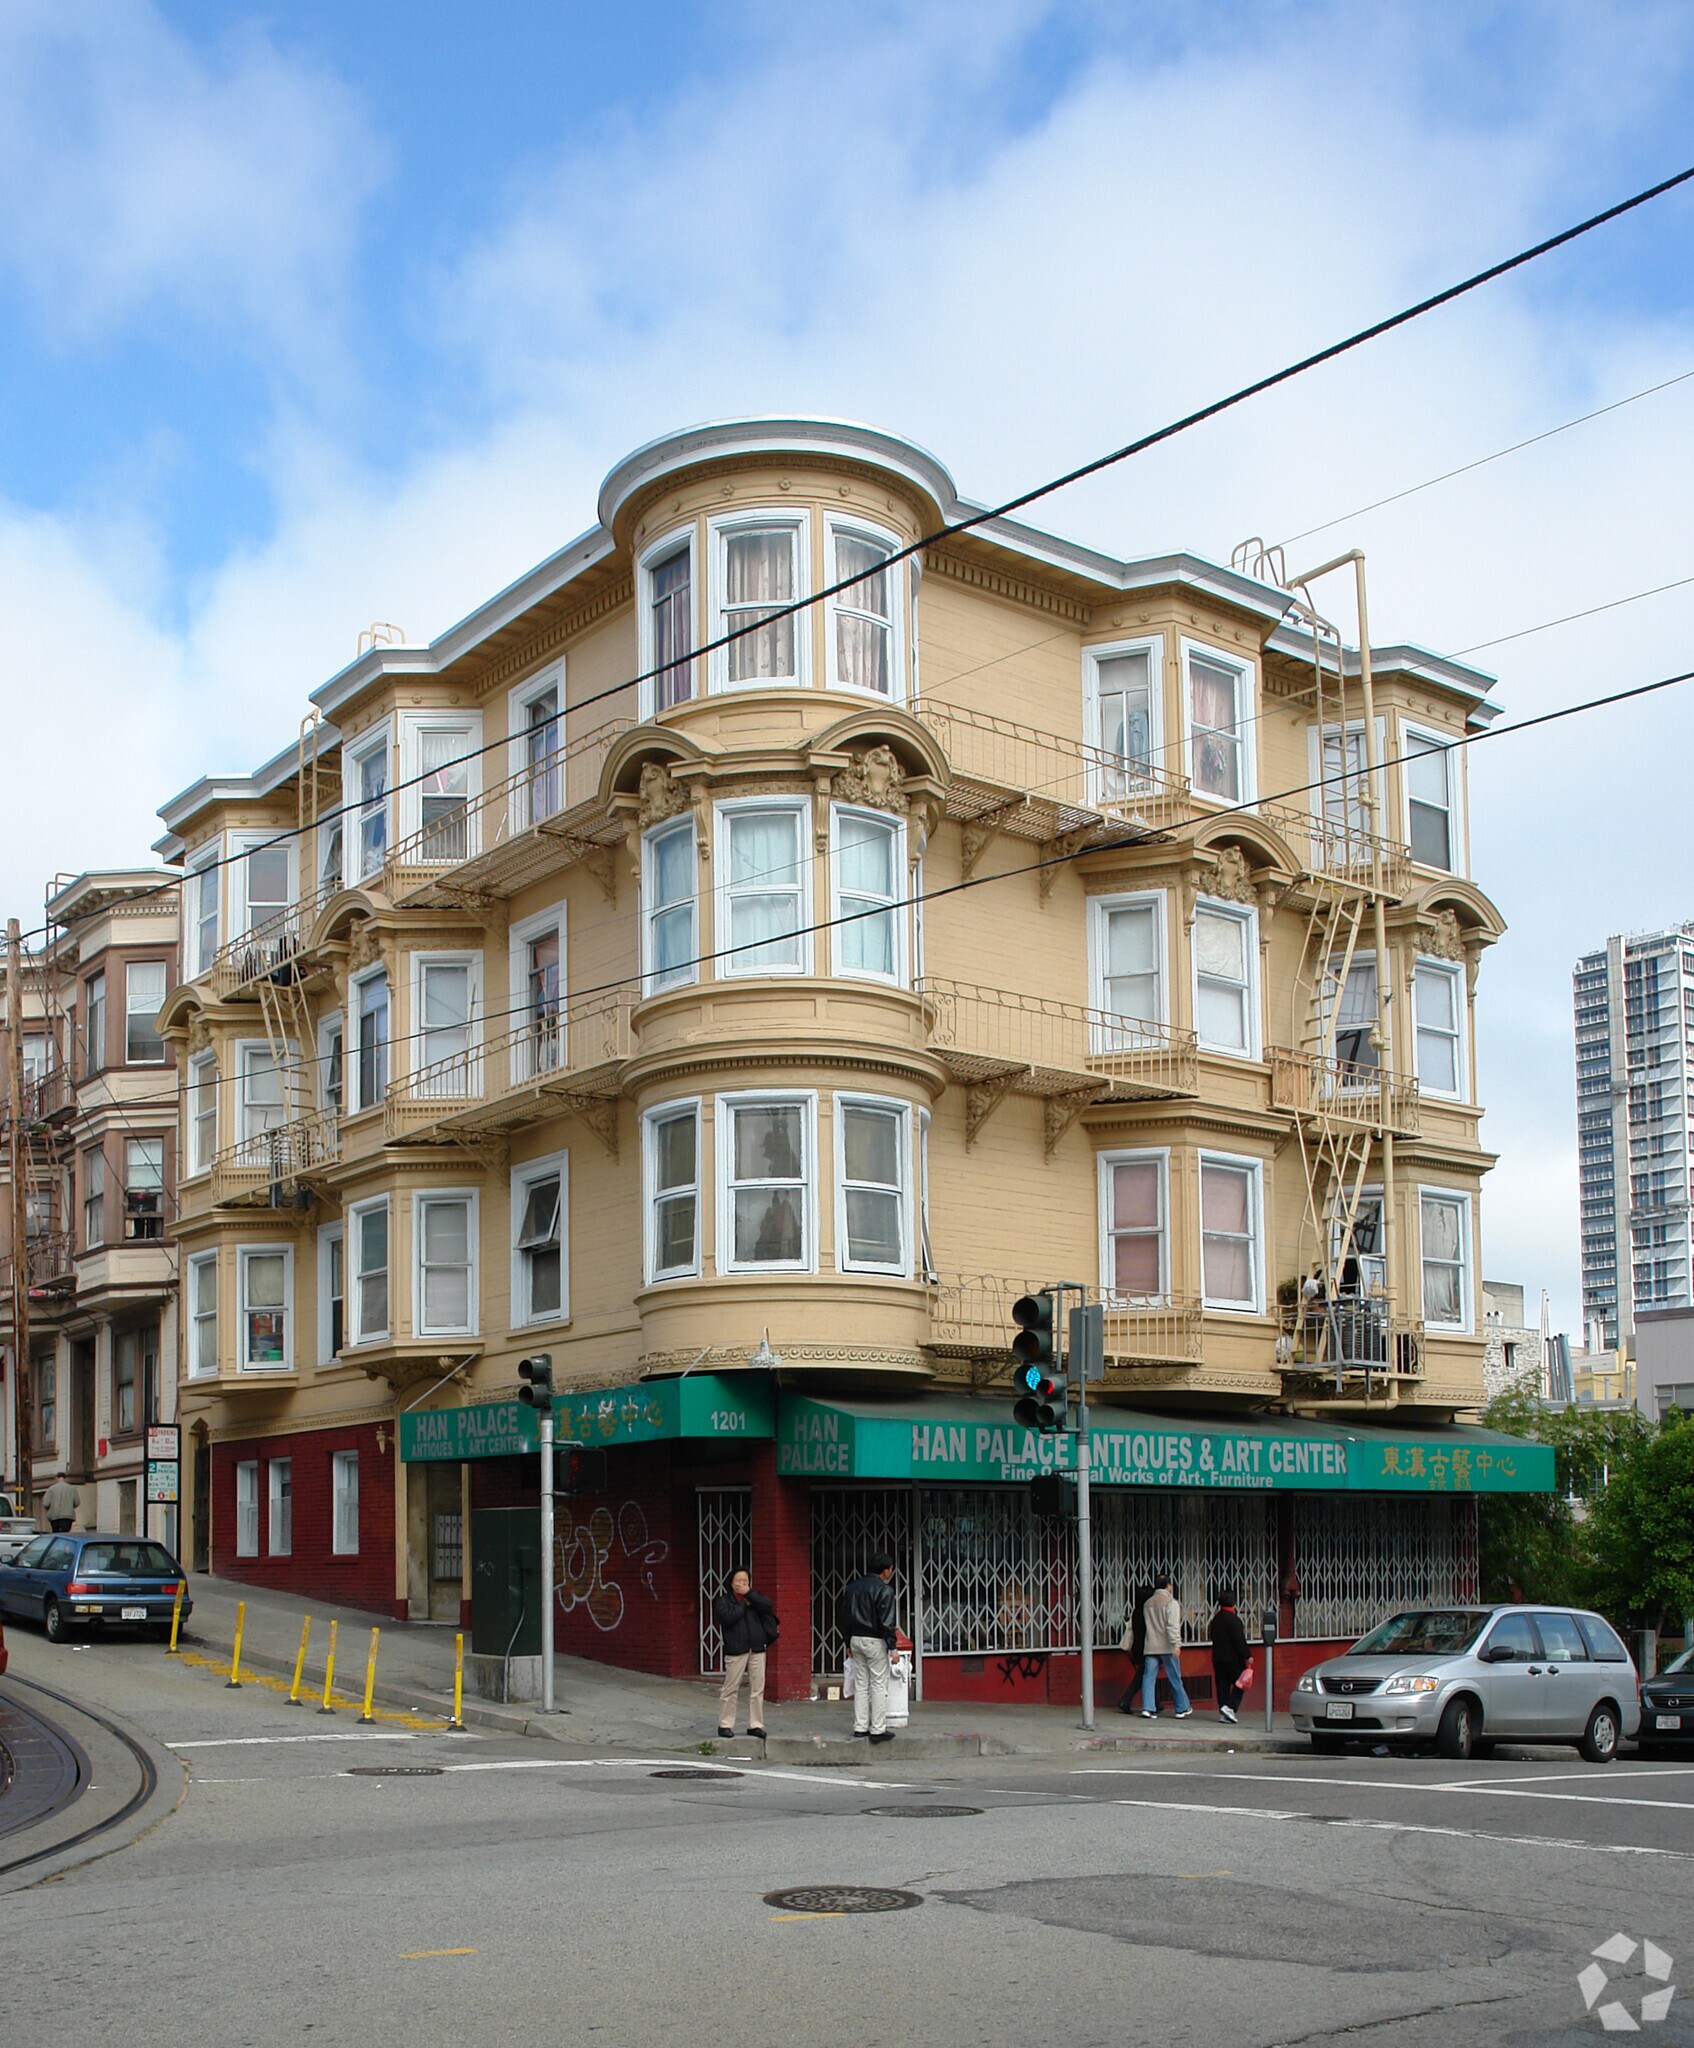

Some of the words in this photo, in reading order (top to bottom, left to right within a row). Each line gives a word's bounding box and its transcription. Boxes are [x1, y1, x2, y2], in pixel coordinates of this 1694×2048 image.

[415, 1413, 449, 1442] HAN
[457, 1406, 519, 1439] PALACE
[711, 1410, 746, 1431] 1201
[793, 1413, 839, 1442] HAN
[411, 1441, 454, 1458] ANTIQUES
[457, 1440, 465, 1455] &
[469, 1438, 486, 1455] ART
[488, 1434, 526, 1453] CENTER
[780, 1443, 849, 1472] PALACE
[912, 1424, 967, 1462] HAN
[975, 1427, 1069, 1467] PALACE
[1199, 1437, 1214, 1471] &
[1221, 1439, 1263, 1472] ART
[1269, 1441, 1347, 1475] CENTER
[148, 1463, 156, 1473] 2
[1001, 1463, 1036, 1481] Fine
[1108, 1467, 1154, 1483] Works
[1159, 1469, 1174, 1485] of
[1177, 1470, 1205, 1486] Art,
[1211, 1471, 1274, 1488] Furniture
